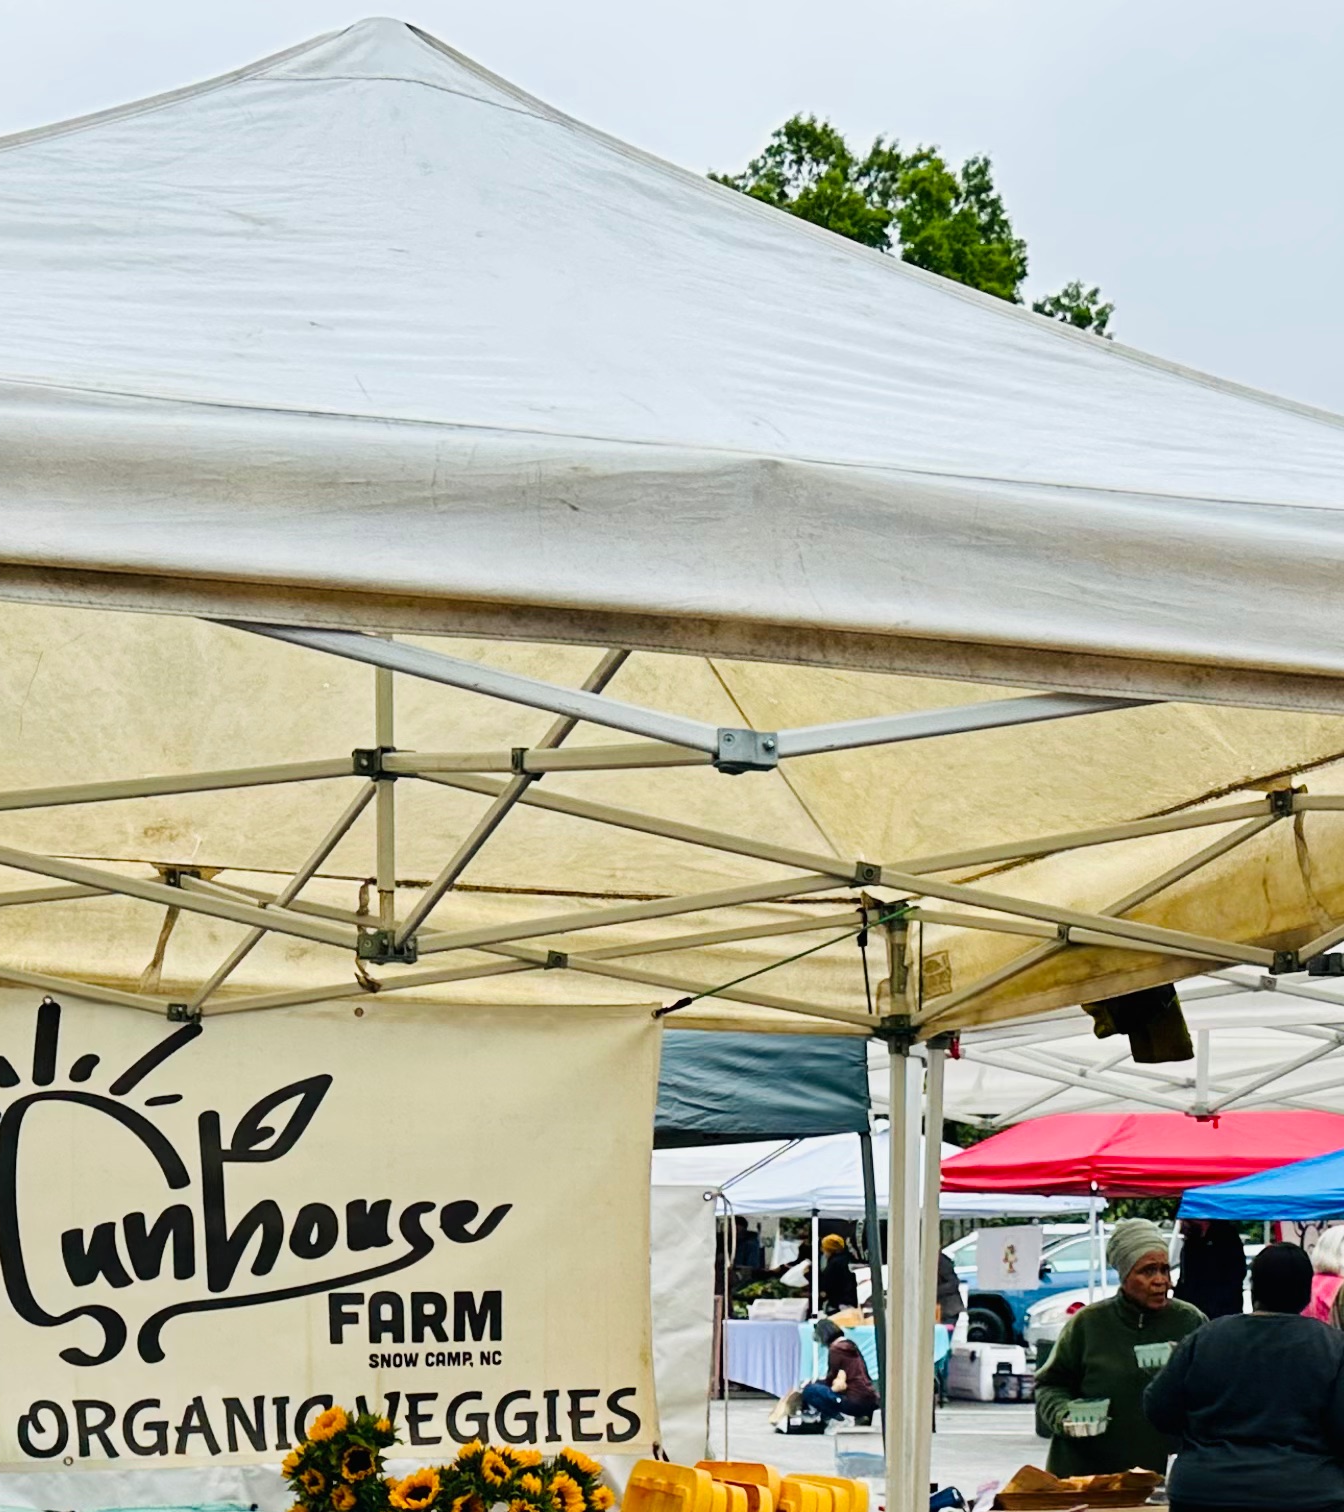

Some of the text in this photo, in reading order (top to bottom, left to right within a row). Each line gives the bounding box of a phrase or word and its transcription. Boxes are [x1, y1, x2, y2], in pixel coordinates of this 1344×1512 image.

[328, 1290, 503, 1345] FARM
[368, 1350, 502, 1369] SNOW CAMP, NC
